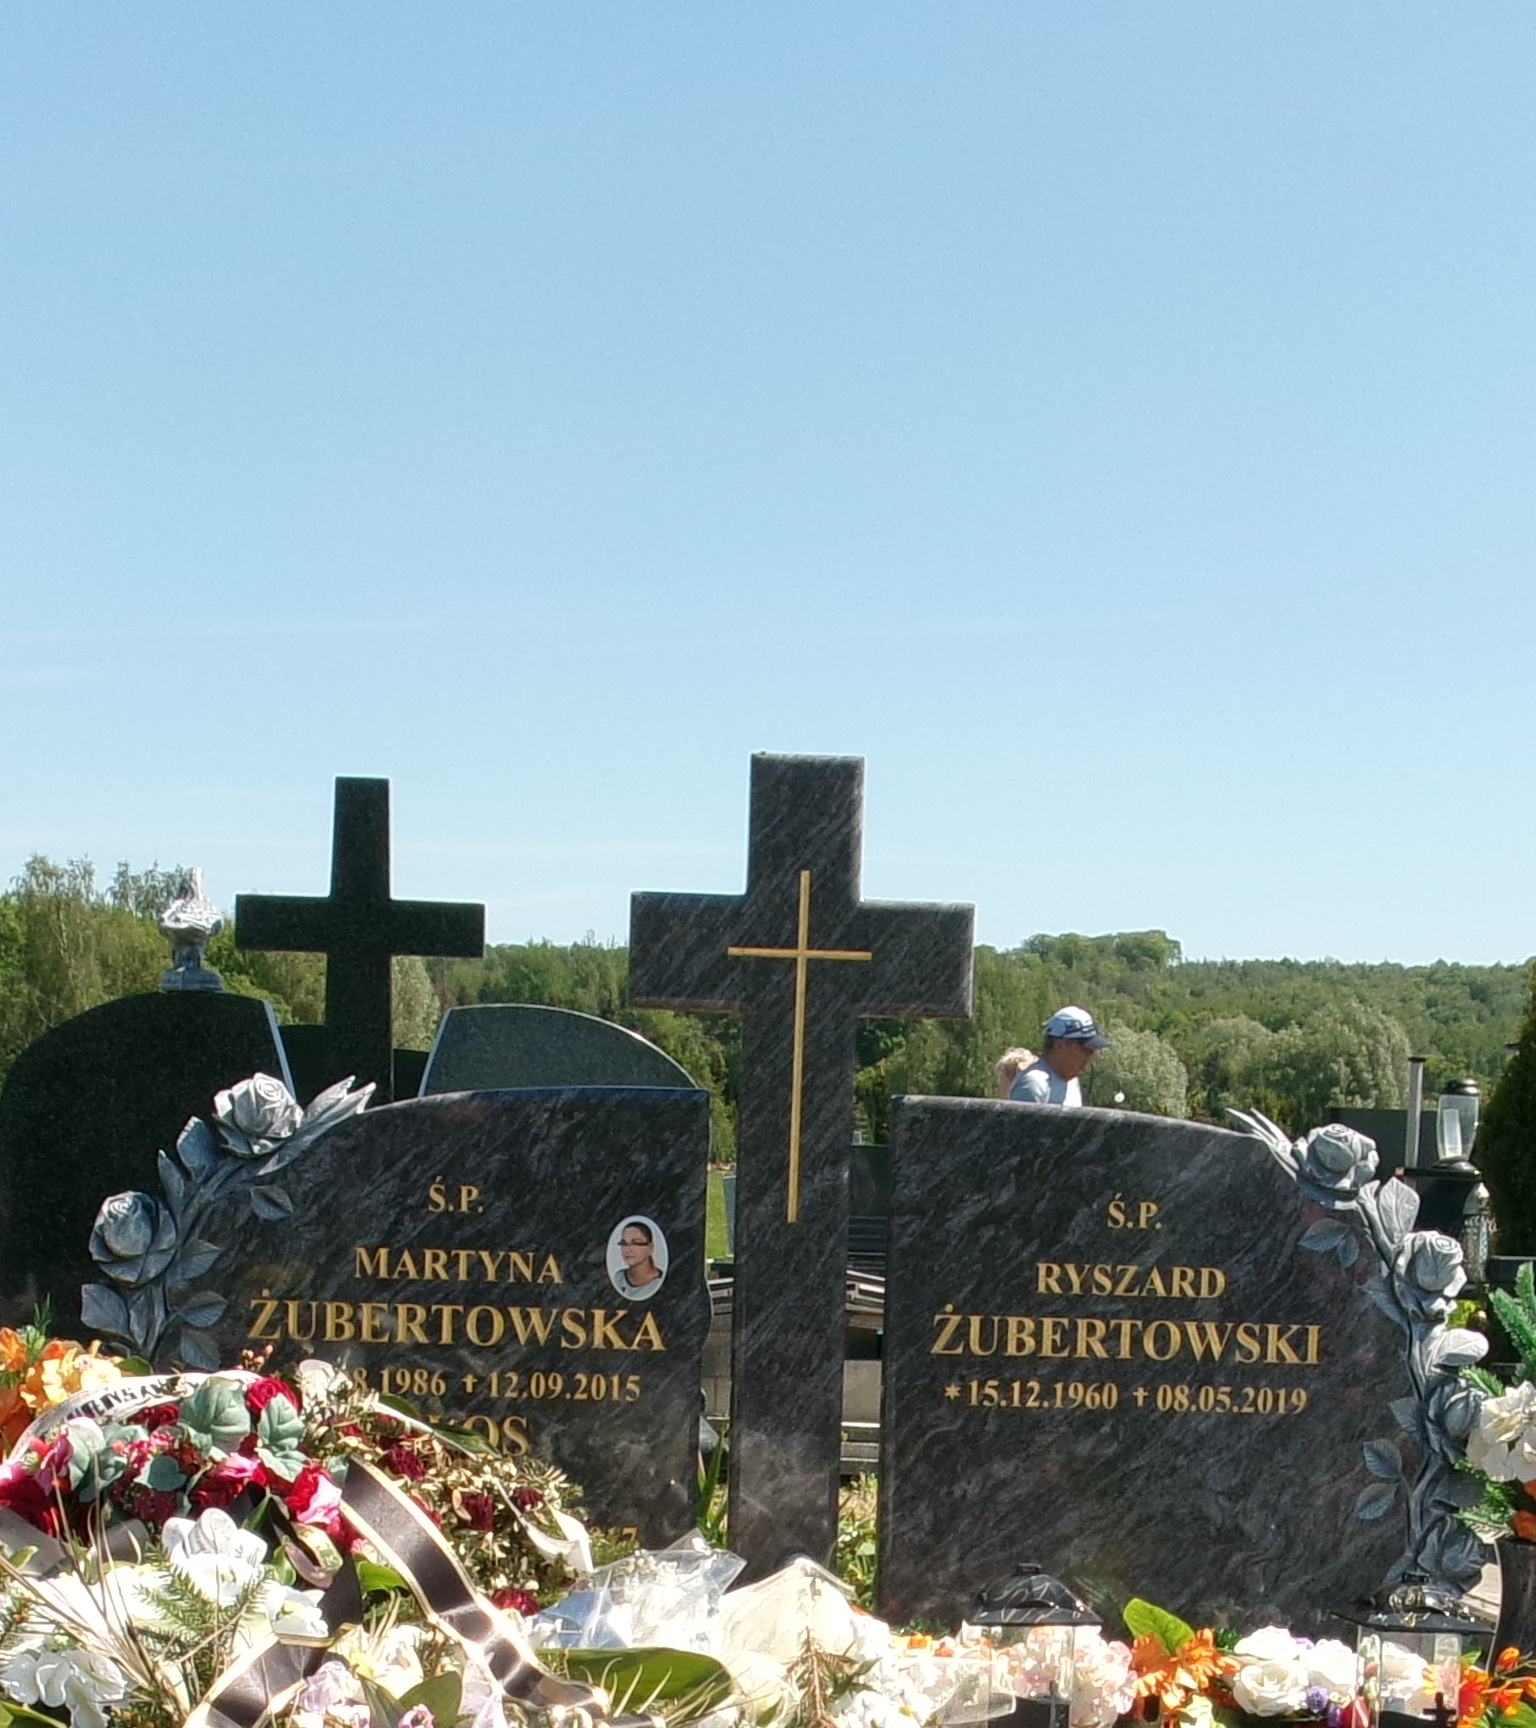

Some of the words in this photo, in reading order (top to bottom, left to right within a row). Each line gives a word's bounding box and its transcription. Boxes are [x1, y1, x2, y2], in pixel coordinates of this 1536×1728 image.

[428, 1176, 484, 1213] Ś.P.
[1107, 1192, 1163, 1230] Ś.P.
[354, 1246, 564, 1284] MARTYNA
[1035, 1262, 1227, 1299] RYSZARD
[247, 1288, 667, 1351] ŻUBERTOWSKA
[930, 1303, 1323, 1365] ŻUBERTOWSKI
